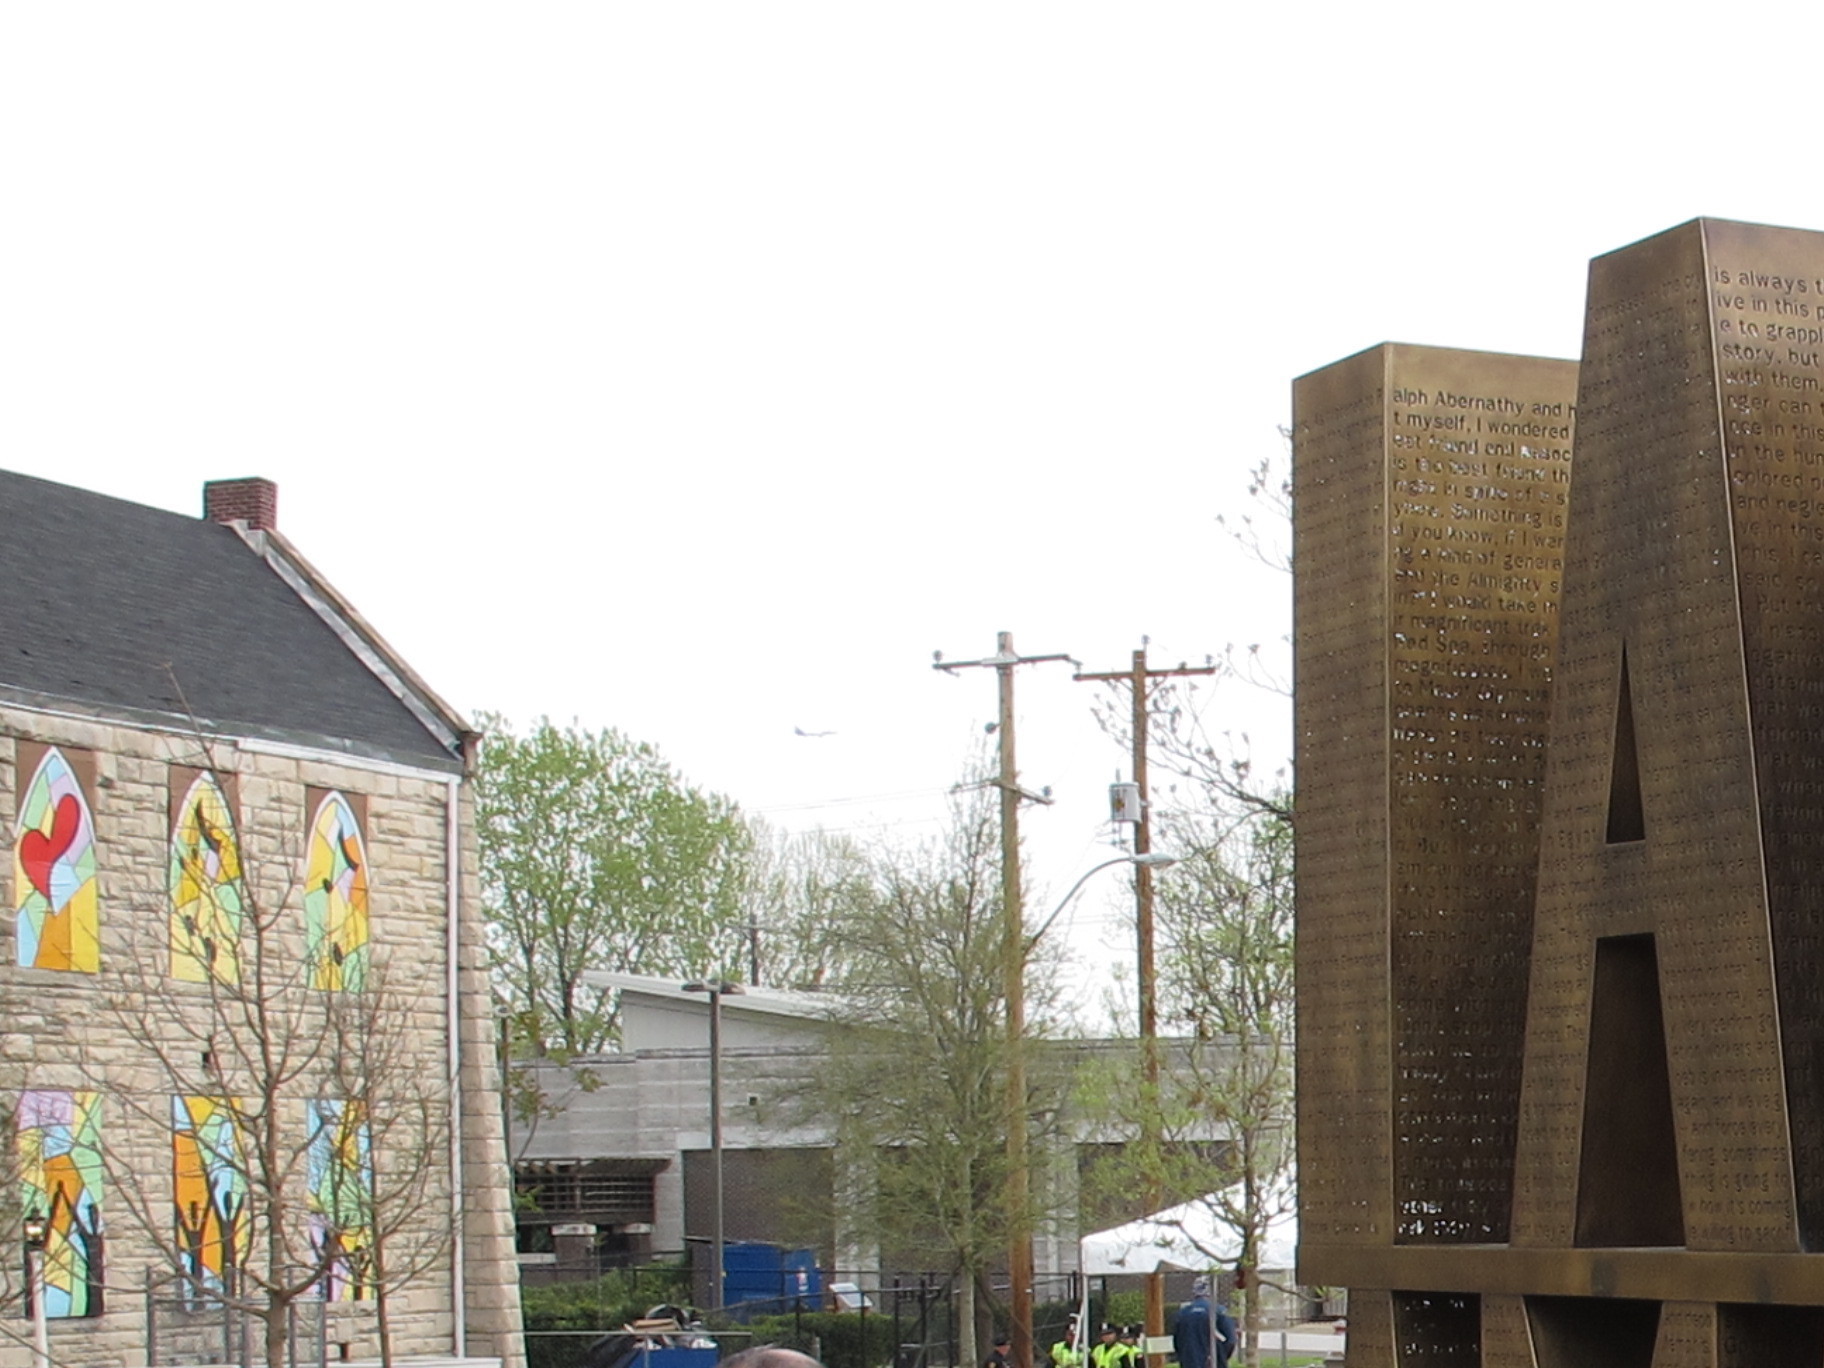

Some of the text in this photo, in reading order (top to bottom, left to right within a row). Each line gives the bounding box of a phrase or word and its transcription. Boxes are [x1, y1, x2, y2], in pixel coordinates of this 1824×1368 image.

[1713, 266, 1808, 295] is always
[1751, 295, 1809, 319] in this
[1788, 349, 1820, 369] but
[1434, 389, 1563, 419] Abernathy and
[1406, 412, 1472, 434] myself,
[1487, 421, 1570, 440] wondered
